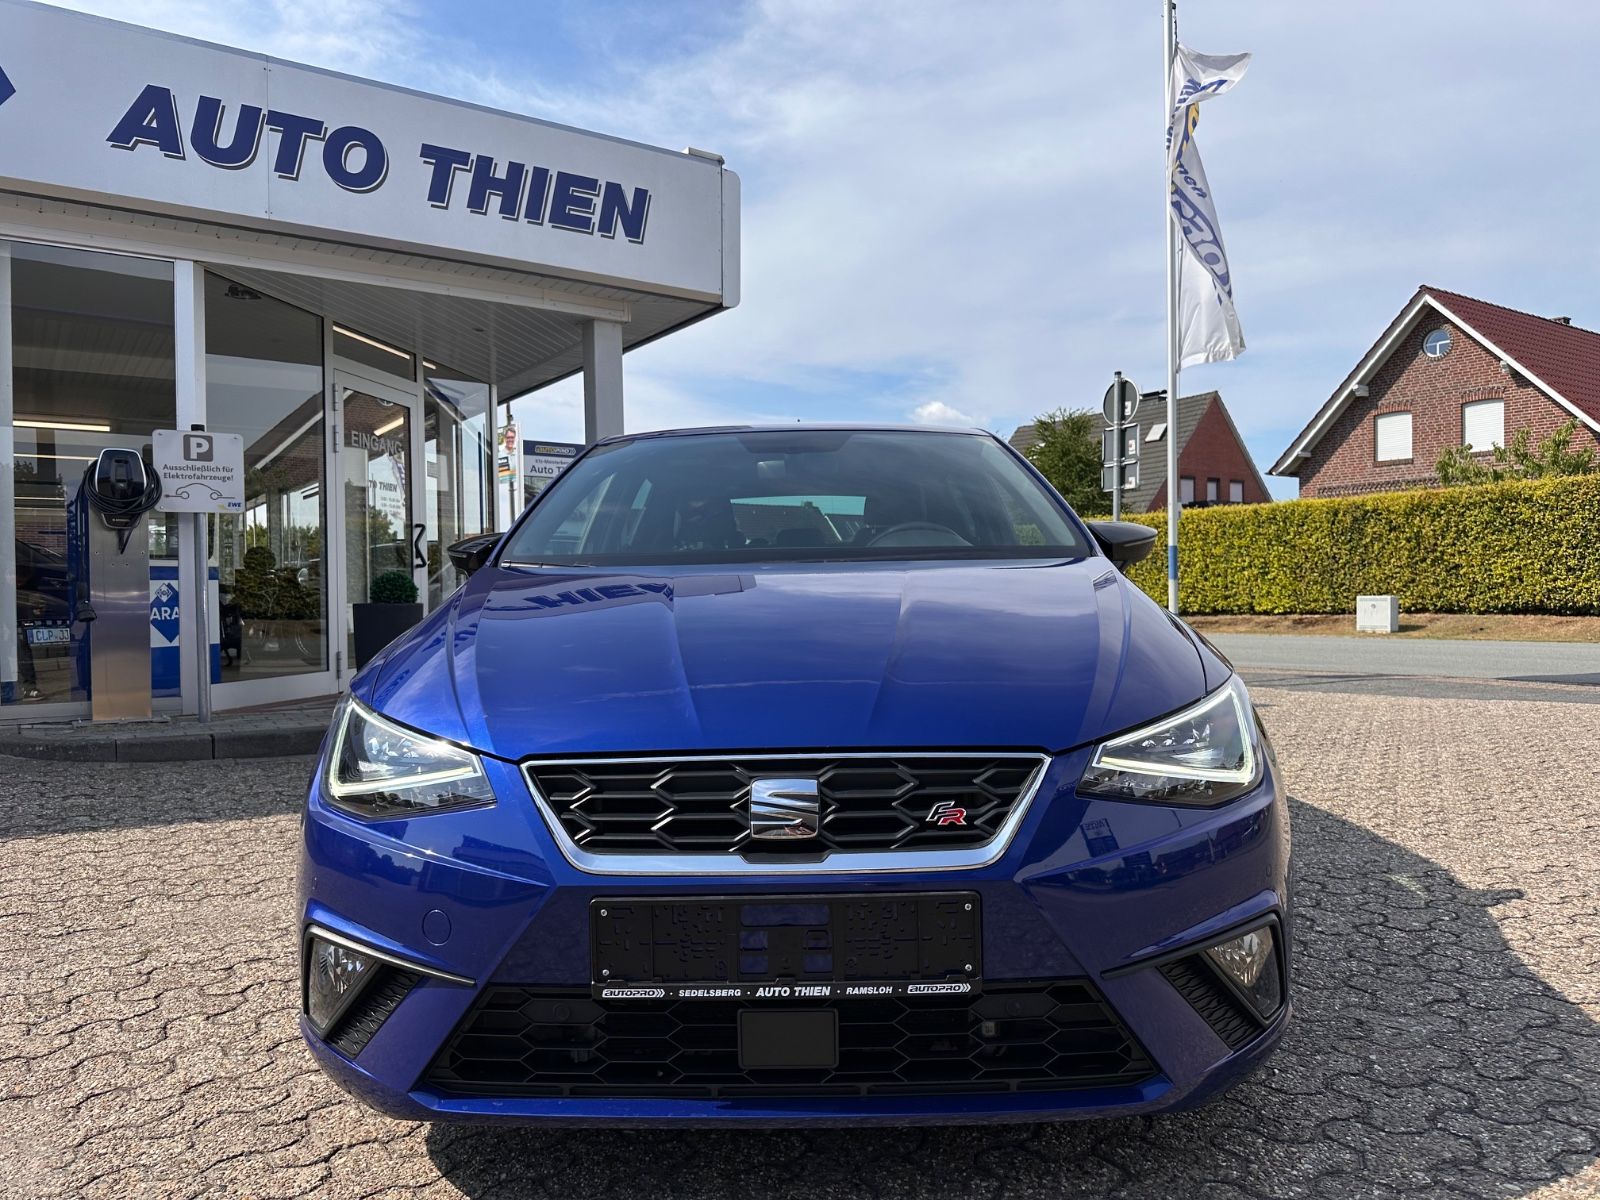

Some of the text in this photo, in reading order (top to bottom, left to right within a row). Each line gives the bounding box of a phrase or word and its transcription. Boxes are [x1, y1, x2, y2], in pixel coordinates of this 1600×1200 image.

[105, 84, 651, 245] AUTO THIEN
[351, 430, 403, 457] EINGANG
[162, 464, 220, 473] Ausschließlich
[530, 465, 554, 474] Auto
[163, 472, 234, 482] Elektrofahrzeuge!
[150, 606, 179, 620] ARA
[926, 801, 967, 826] FR
[678, 989, 742, 998] SEDELSBERG
[755, 987, 790, 997] AUTO
[793, 986, 831, 997] THIEN
[846, 986, 893, 995] RAMSLOH
